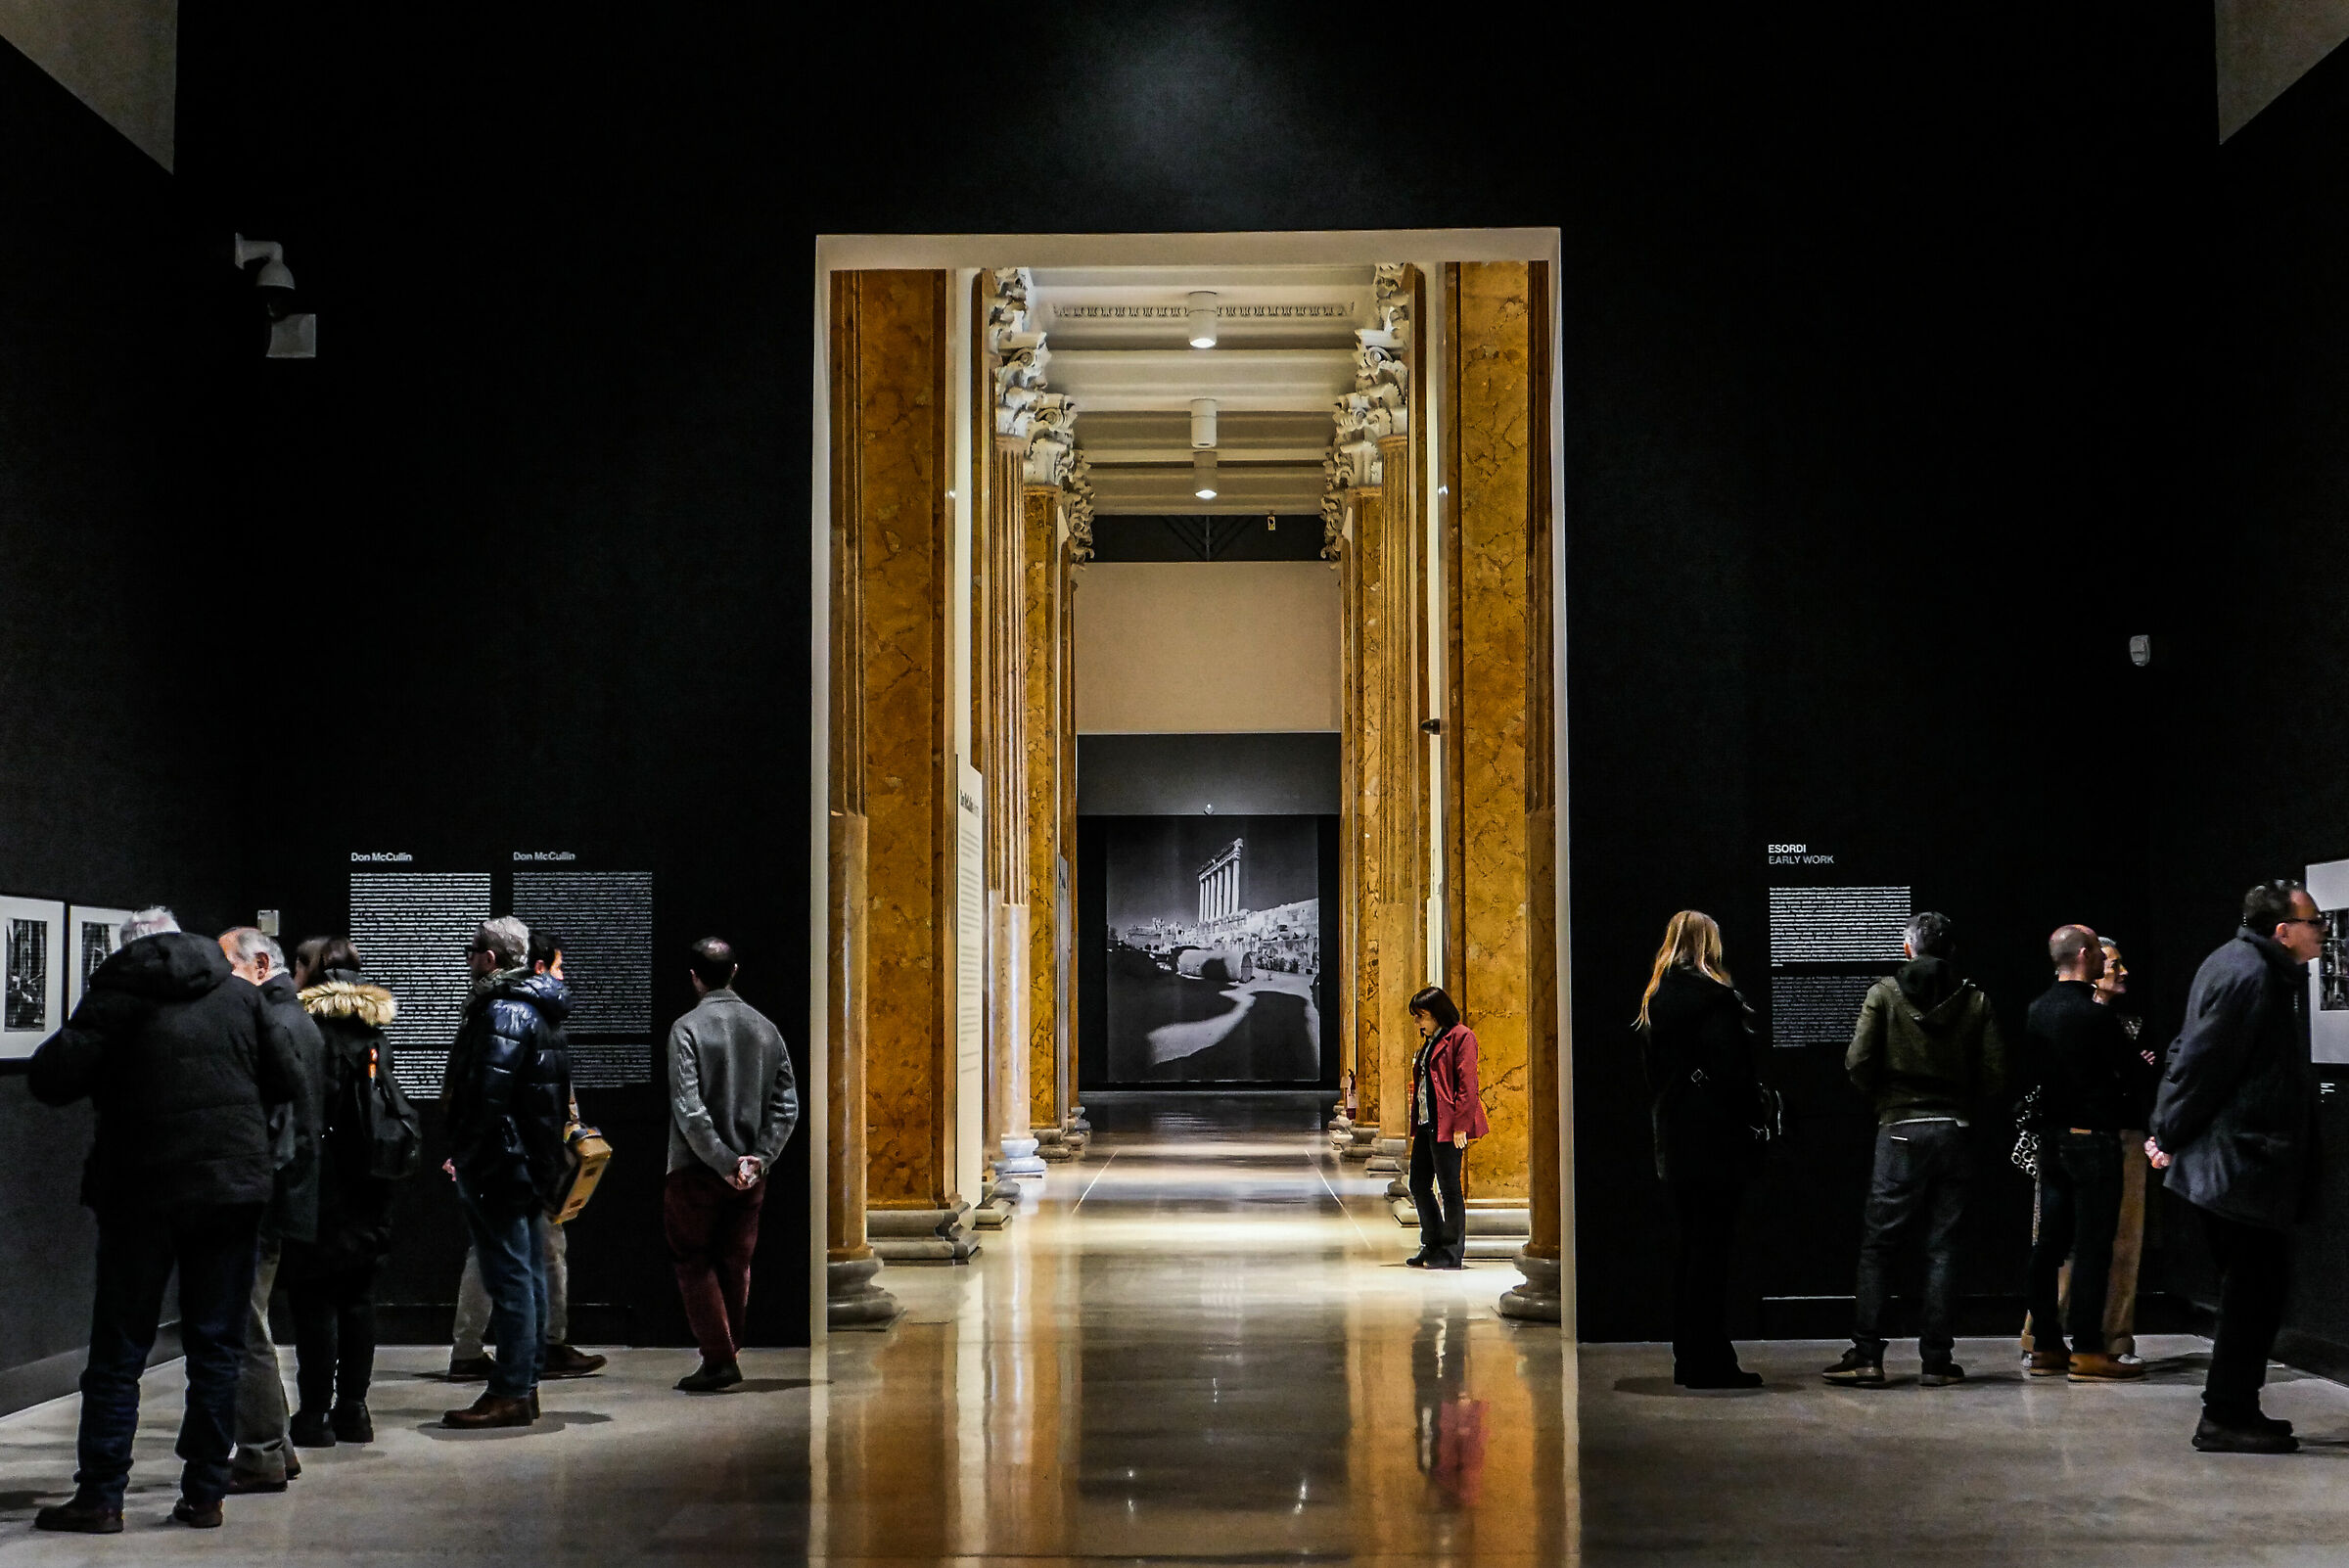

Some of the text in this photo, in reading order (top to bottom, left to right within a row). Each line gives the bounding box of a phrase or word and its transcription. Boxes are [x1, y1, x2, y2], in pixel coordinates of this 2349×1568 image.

[1768, 844, 1807, 853] ESORDI
[350, 853, 371, 861] Don
[513, 852, 533, 860] Don
[1769, 854, 1834, 864] EARLY WORK
